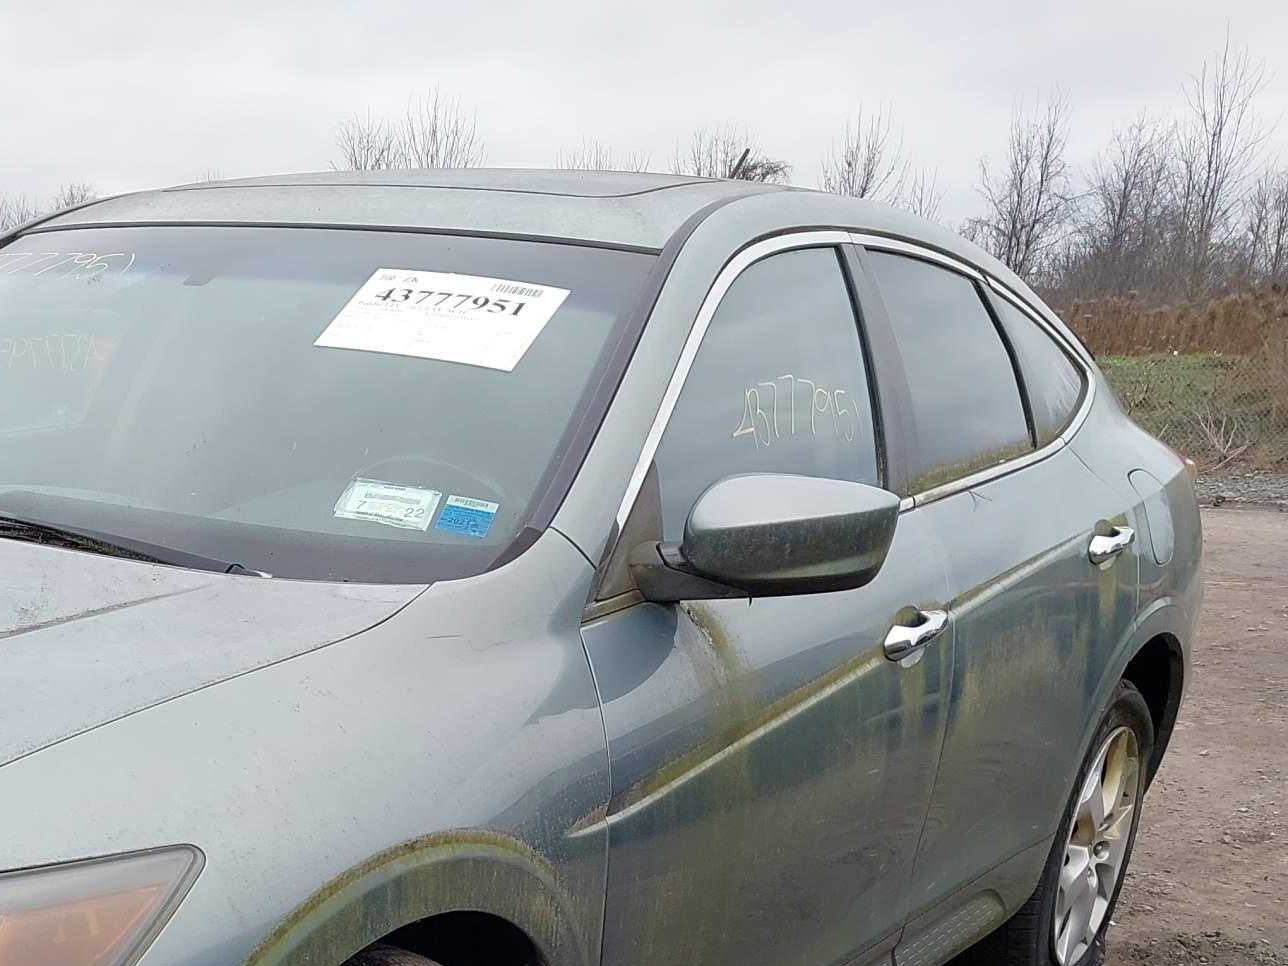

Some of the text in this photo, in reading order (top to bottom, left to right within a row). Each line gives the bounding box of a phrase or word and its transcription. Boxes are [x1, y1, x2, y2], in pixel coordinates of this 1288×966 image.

[374, 287, 527, 317] 43777951
[731, 374, 863, 452] 43777951
[403, 507, 425, 519] 22
